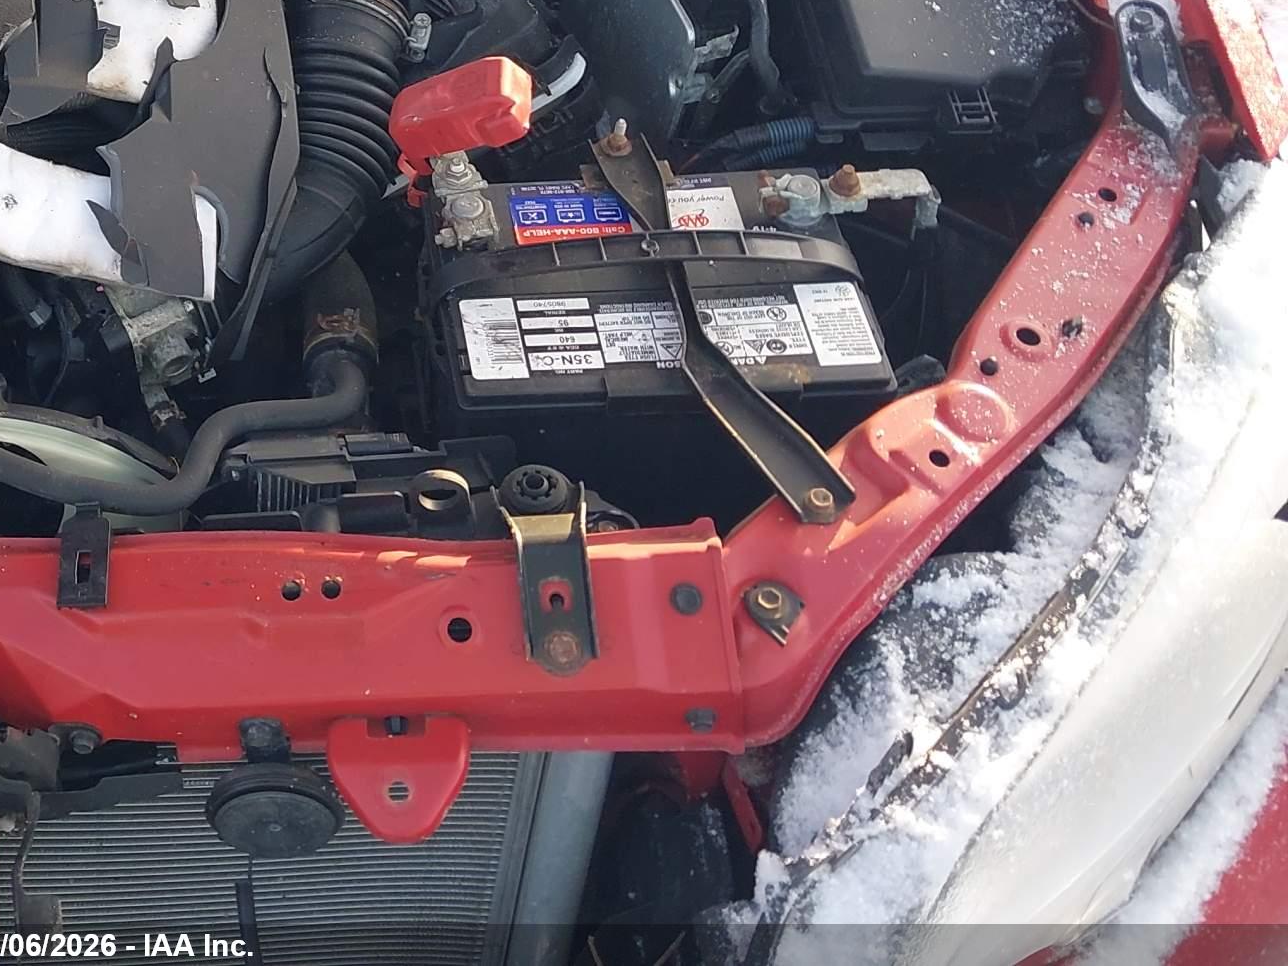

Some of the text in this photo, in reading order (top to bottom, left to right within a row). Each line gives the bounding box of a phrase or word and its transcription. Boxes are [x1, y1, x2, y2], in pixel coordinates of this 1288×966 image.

[697, 195, 724, 203] Power
[678, 215, 710, 228] AAA
[523, 226, 600, 237] 800-AAA-HELP
[558, 319, 569, 327] 95
[656, 361, 681, 369] SON
[730, 357, 755, 365] DAN
